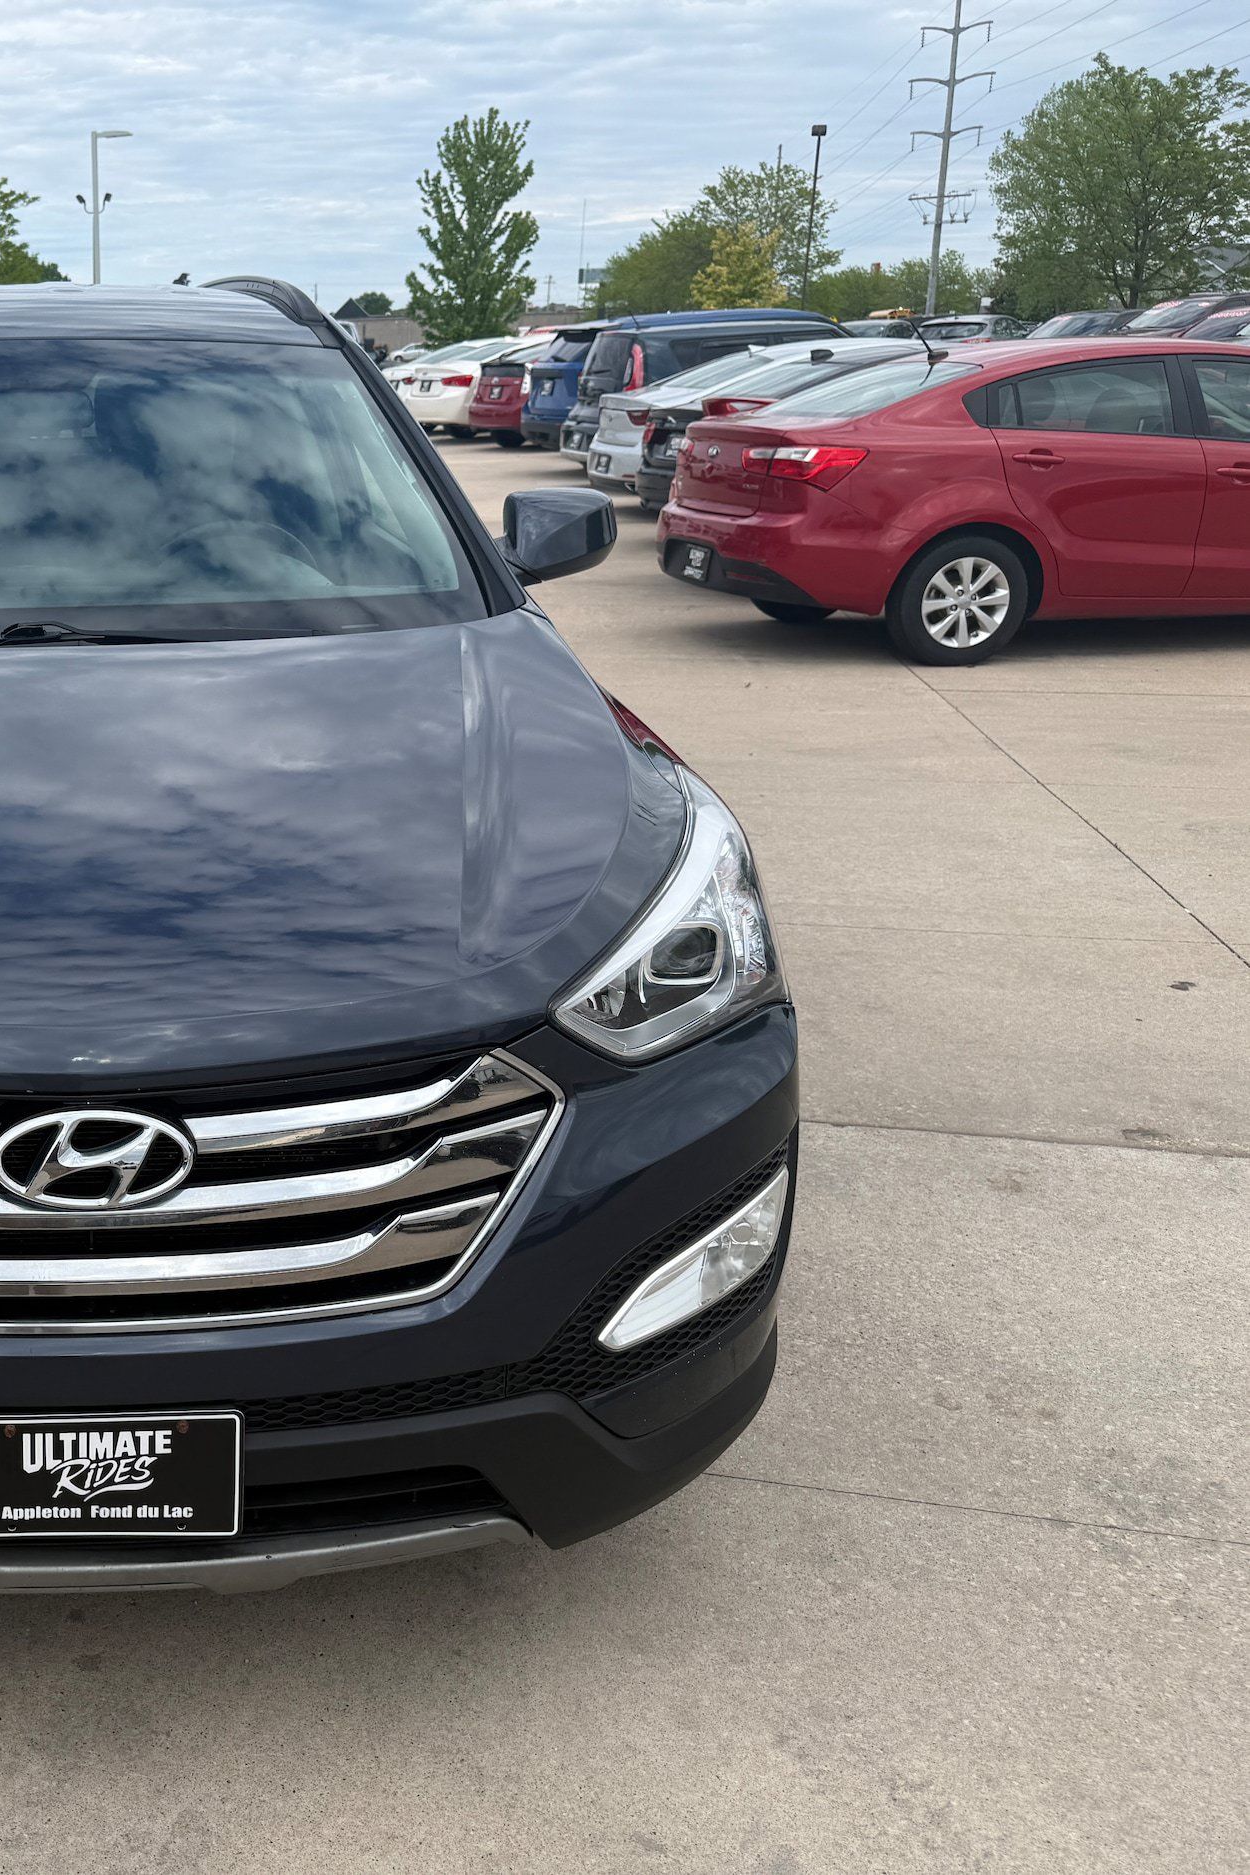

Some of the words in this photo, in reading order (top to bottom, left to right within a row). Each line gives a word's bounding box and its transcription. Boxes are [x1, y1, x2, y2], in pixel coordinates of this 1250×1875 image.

[22, 1429, 173, 1474] ULTIMATE
[1, 1505, 82, 1521] Appleton
[90, 1505, 133, 1519] Fond
[136, 1505, 159, 1519] du
[163, 1505, 194, 1519] Lac
